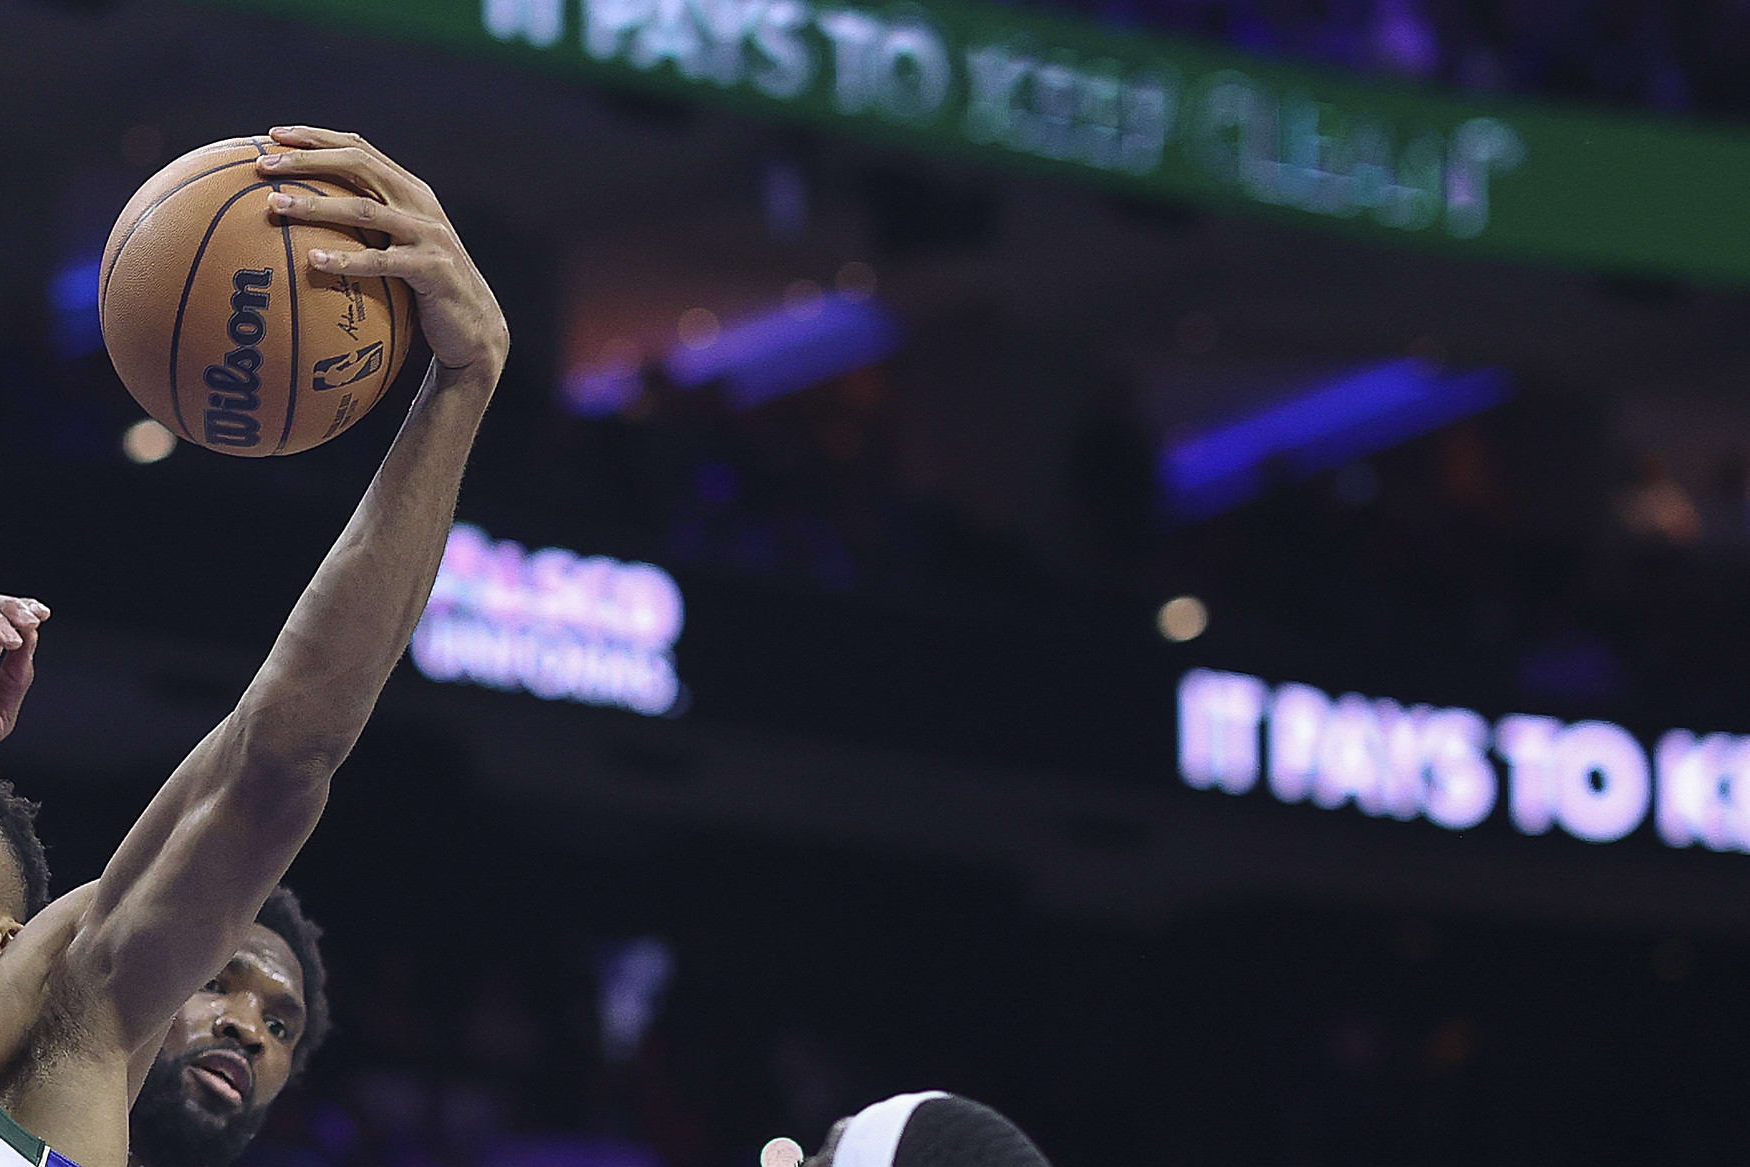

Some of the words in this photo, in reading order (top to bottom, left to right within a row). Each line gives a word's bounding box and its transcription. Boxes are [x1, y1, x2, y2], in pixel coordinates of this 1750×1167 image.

[820, 10, 949, 124] TO
[203, 268, 273, 447] Wilson
[1177, 667, 1269, 795] IT
[1267, 681, 1498, 830] PAYS
[1494, 711, 1649, 843] TO
